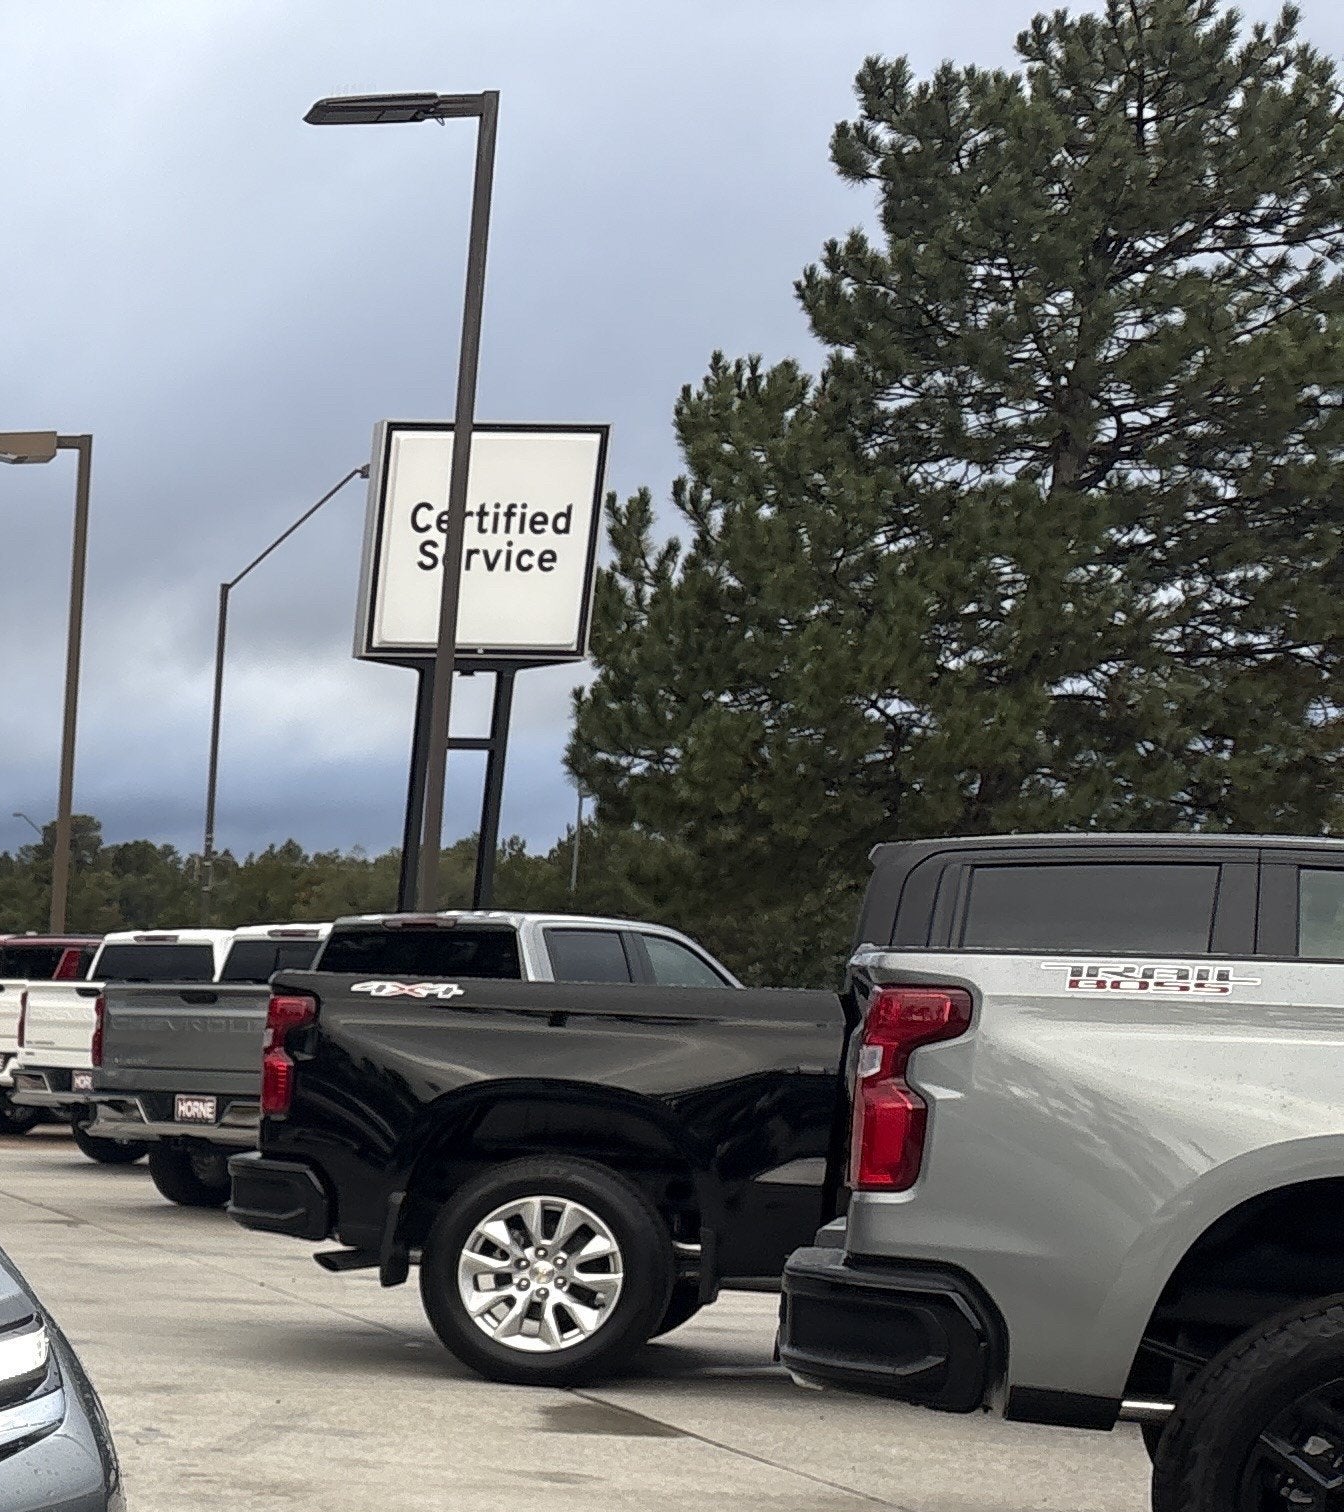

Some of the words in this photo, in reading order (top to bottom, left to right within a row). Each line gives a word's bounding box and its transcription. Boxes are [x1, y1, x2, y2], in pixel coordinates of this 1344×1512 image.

[416, 539, 558, 572] Srvice
[1041, 962, 1262, 986] TRAIL
[1067, 979, 1231, 996] BOSS
[176, 1100, 215, 1119] HORNE
